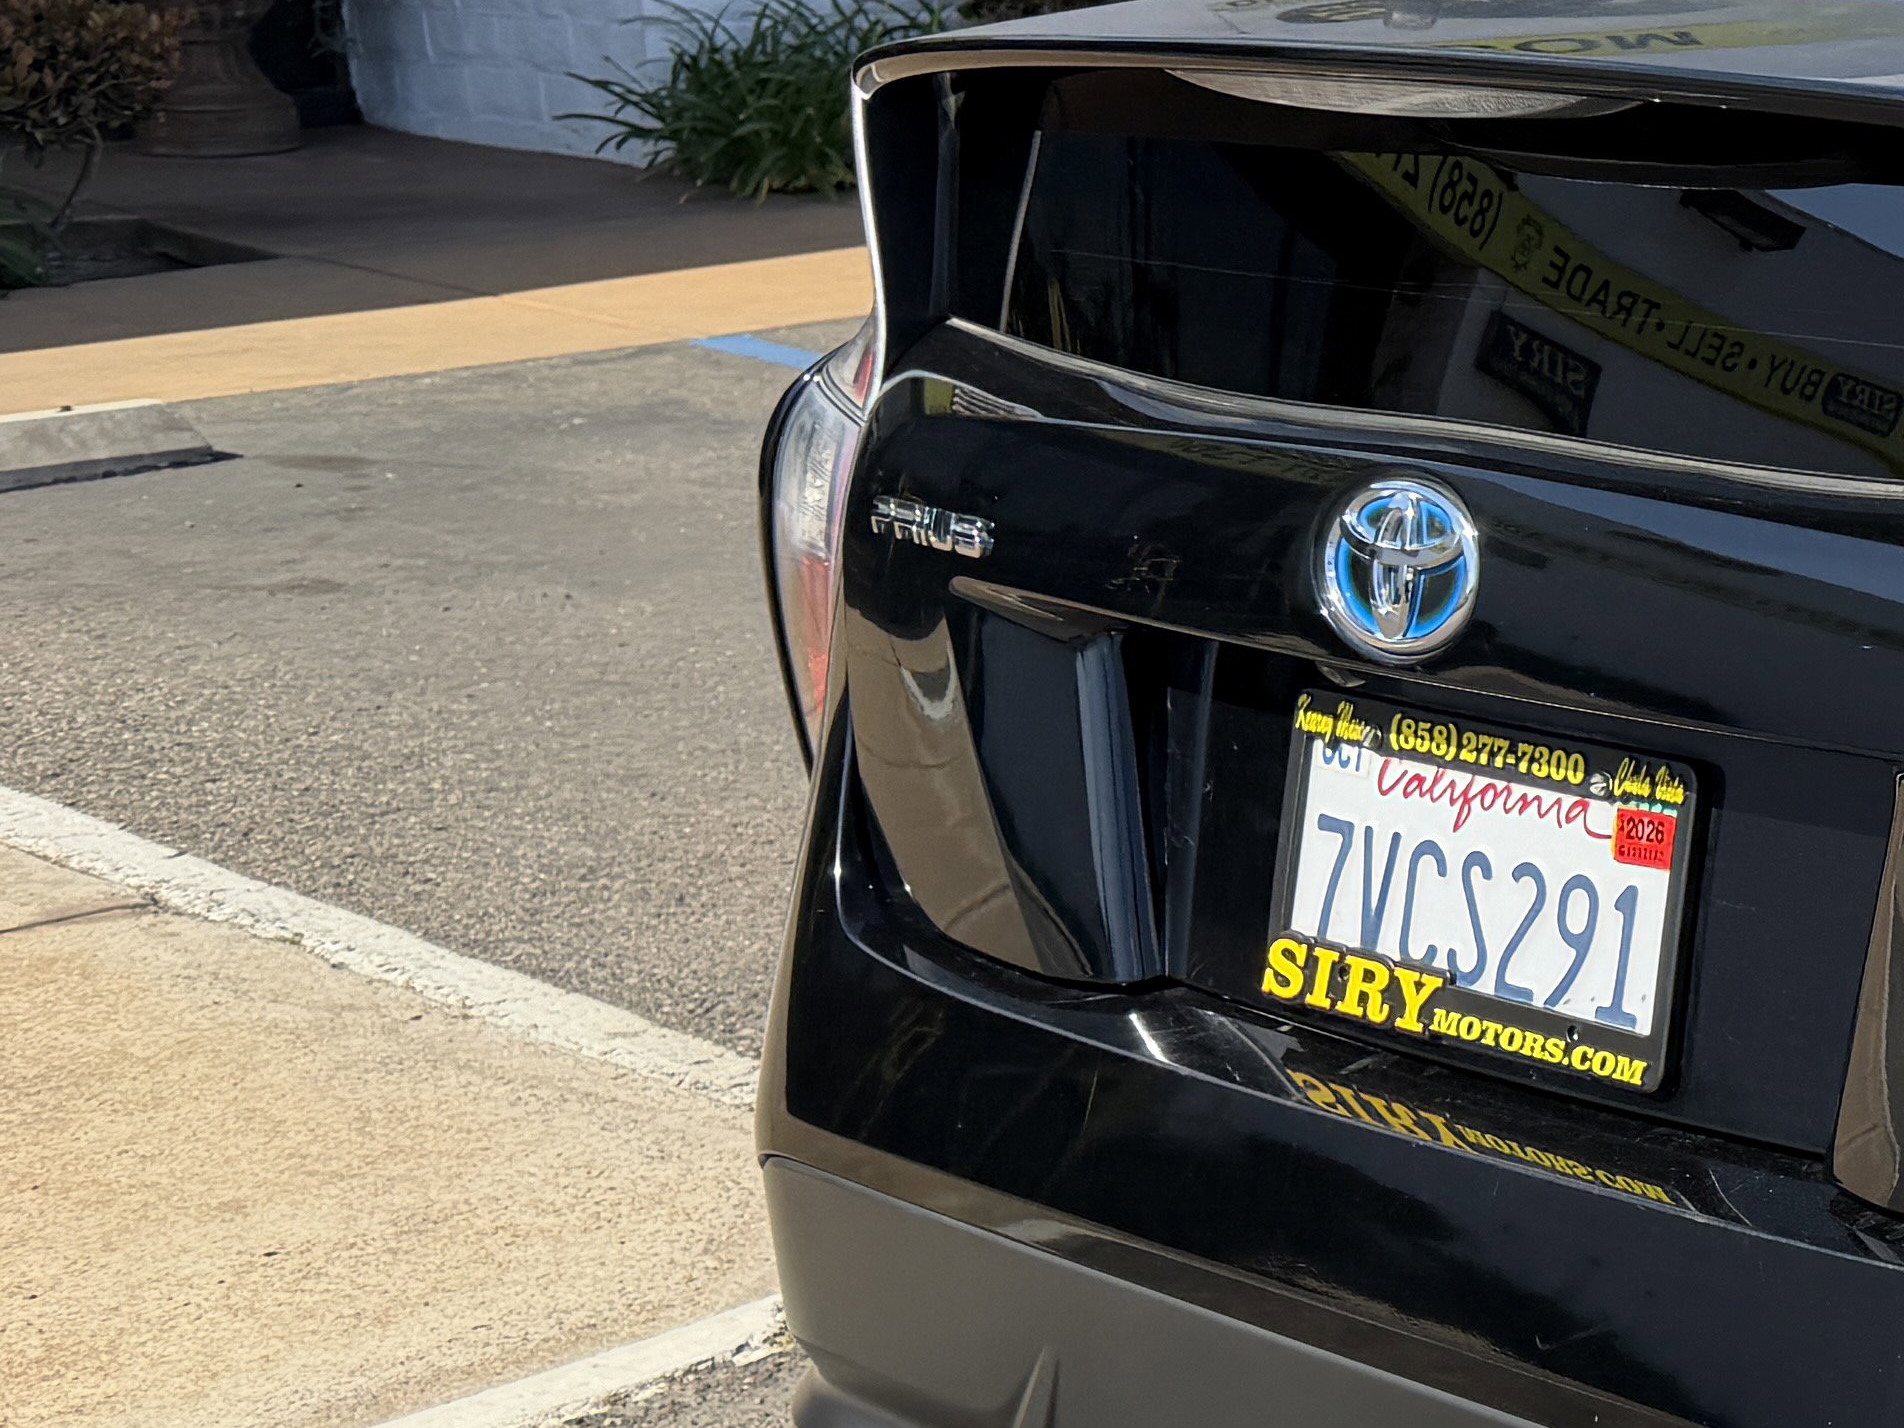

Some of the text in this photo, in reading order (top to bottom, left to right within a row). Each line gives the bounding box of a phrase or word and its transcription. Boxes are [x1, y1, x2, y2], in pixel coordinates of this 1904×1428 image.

[870, 494, 995, 559] PRIUS
[1389, 713, 1586, 785] (858) 277-7300
[1376, 756, 1613, 833] California
[1625, 816, 1665, 845] 2026
[1316, 813, 1639, 1030] 7VCS291
[1261, 936, 1444, 1035] SIRY
[1429, 1007, 1649, 1087] MOTORS.COM
